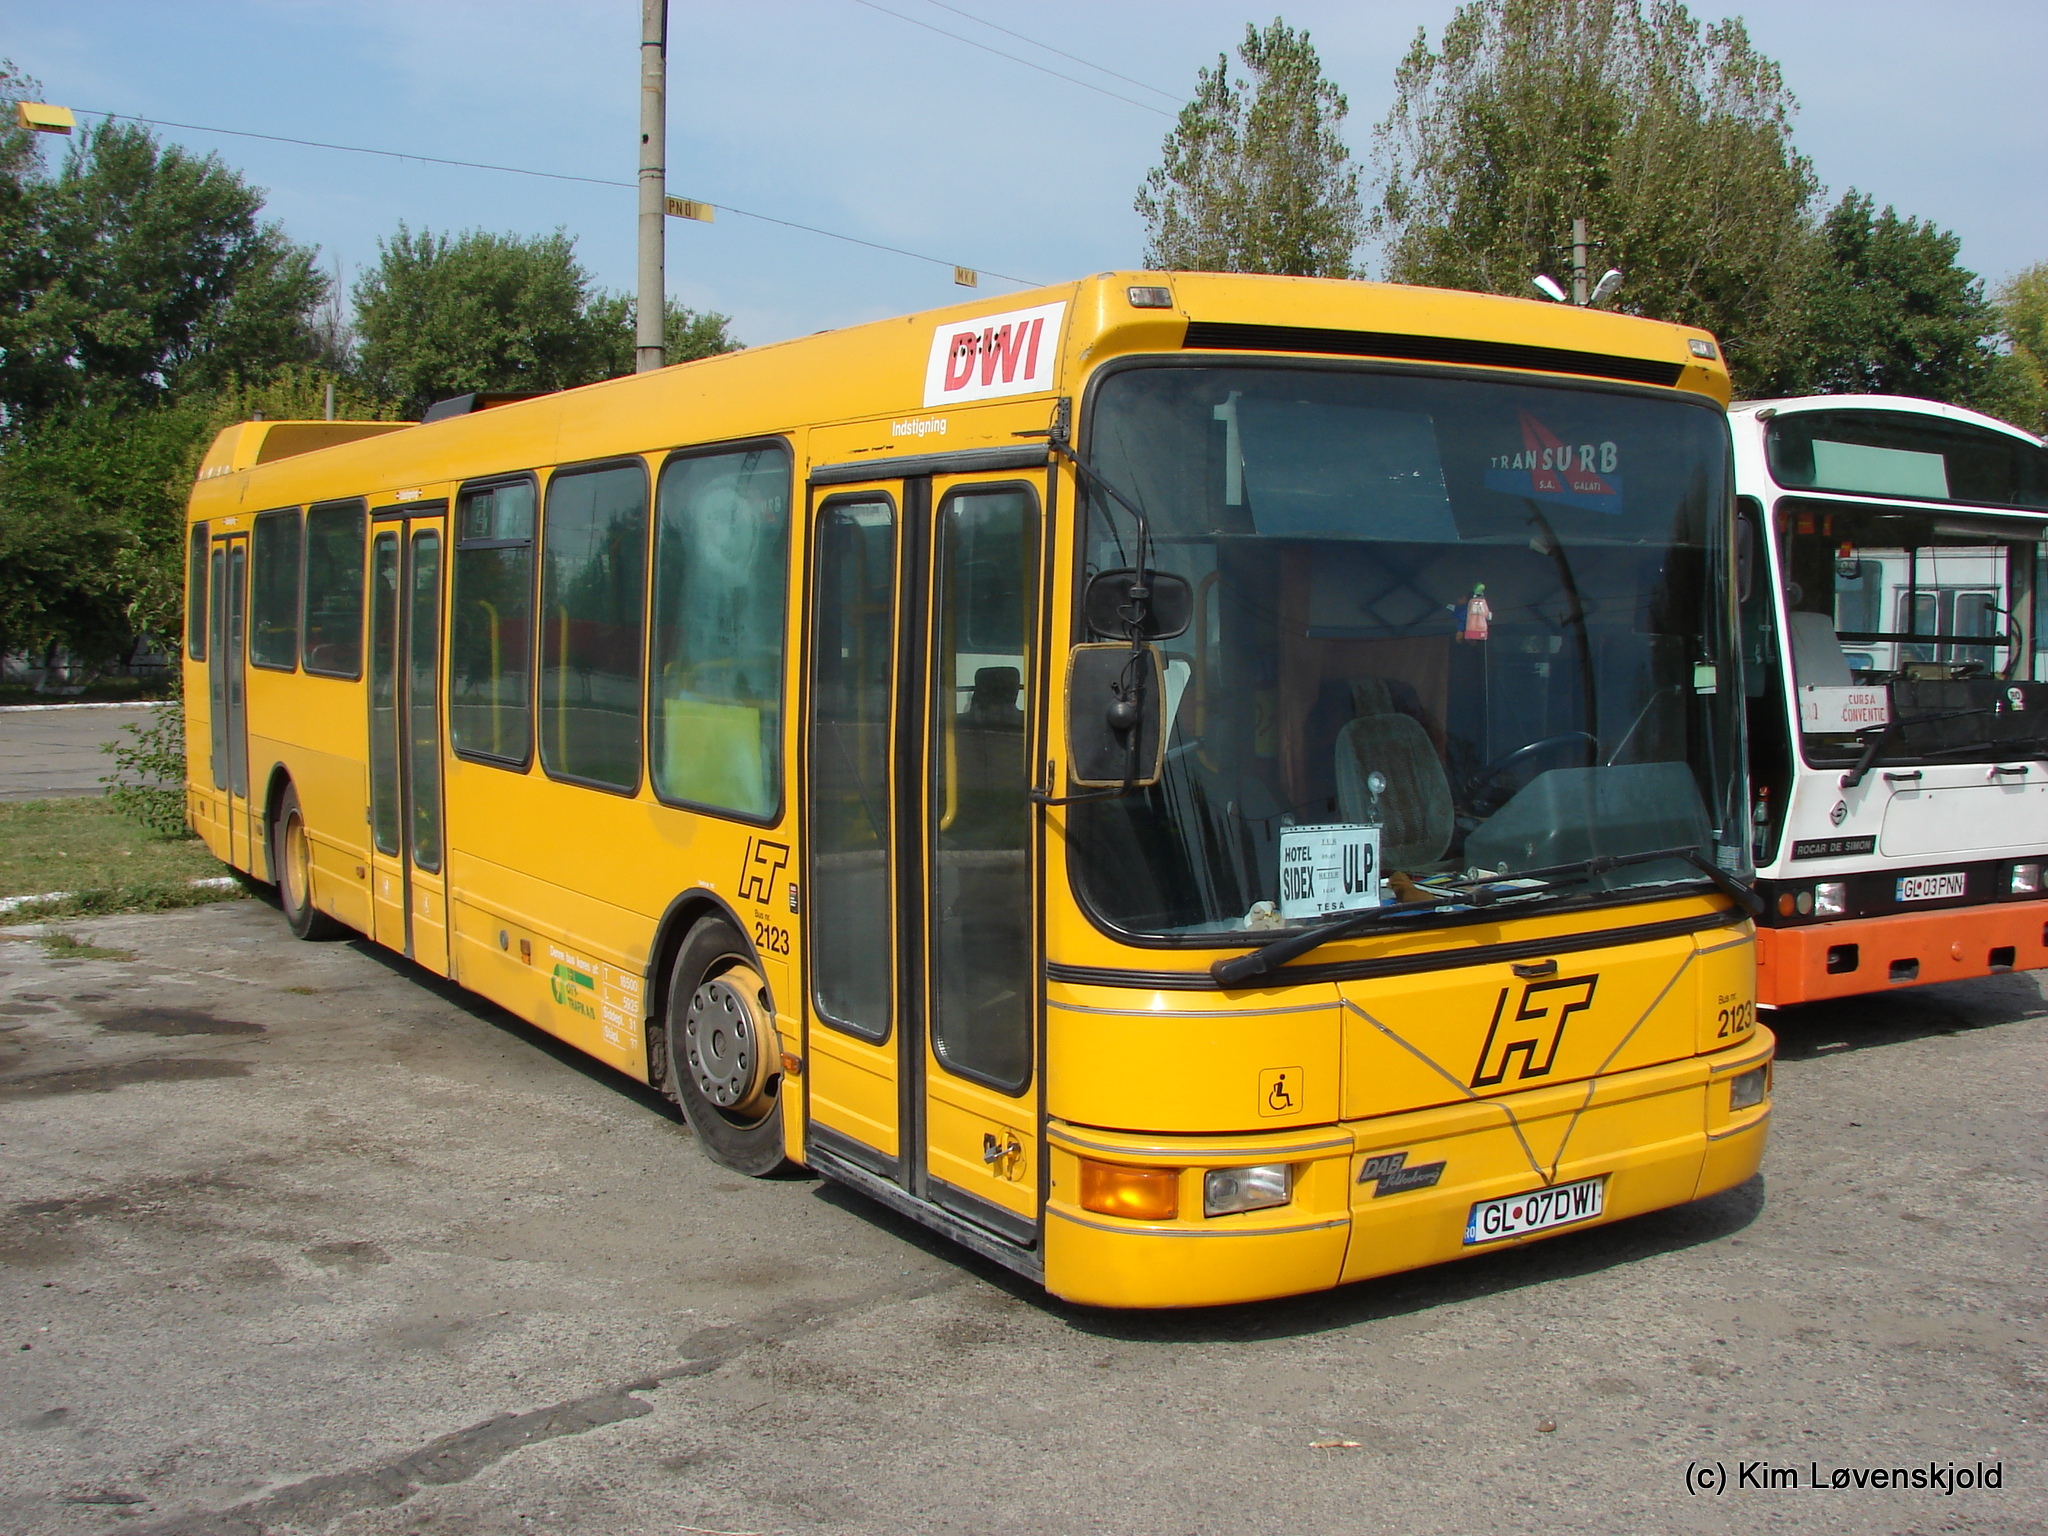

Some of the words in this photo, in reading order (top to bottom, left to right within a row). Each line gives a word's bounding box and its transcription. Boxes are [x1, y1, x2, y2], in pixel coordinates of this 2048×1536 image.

[943, 317, 1045, 392] DWI
[891, 416, 947, 438] Indstigning
[1491, 441, 1617, 473] TRANSURB
[1539, 480, 1555, 489] S.A.
[1848, 694, 1876, 705] CURSA
[1842, 707, 1885, 722] CONVENTIE
[1284, 846, 1312, 862] HOTEL
[1797, 844, 1827, 855] ROCAR
[1829, 843, 1842, 852] DE
[1845, 840, 1871, 851] SIMON
[1343, 843, 1373, 895] ULP
[1283, 866, 1315, 900] SIDEX
[1904, 880, 1920, 898] GL
[1317, 901, 1345, 911] TESA
[755, 921, 790, 956] 2123
[603, 987, 610, 1000] L
[1717, 1000, 1752, 1039] 2123
[1361, 1155, 1404, 1180] DAB
[1483, 1202, 1515, 1234] GL
[1464, 1226, 1476, 1239] RO
